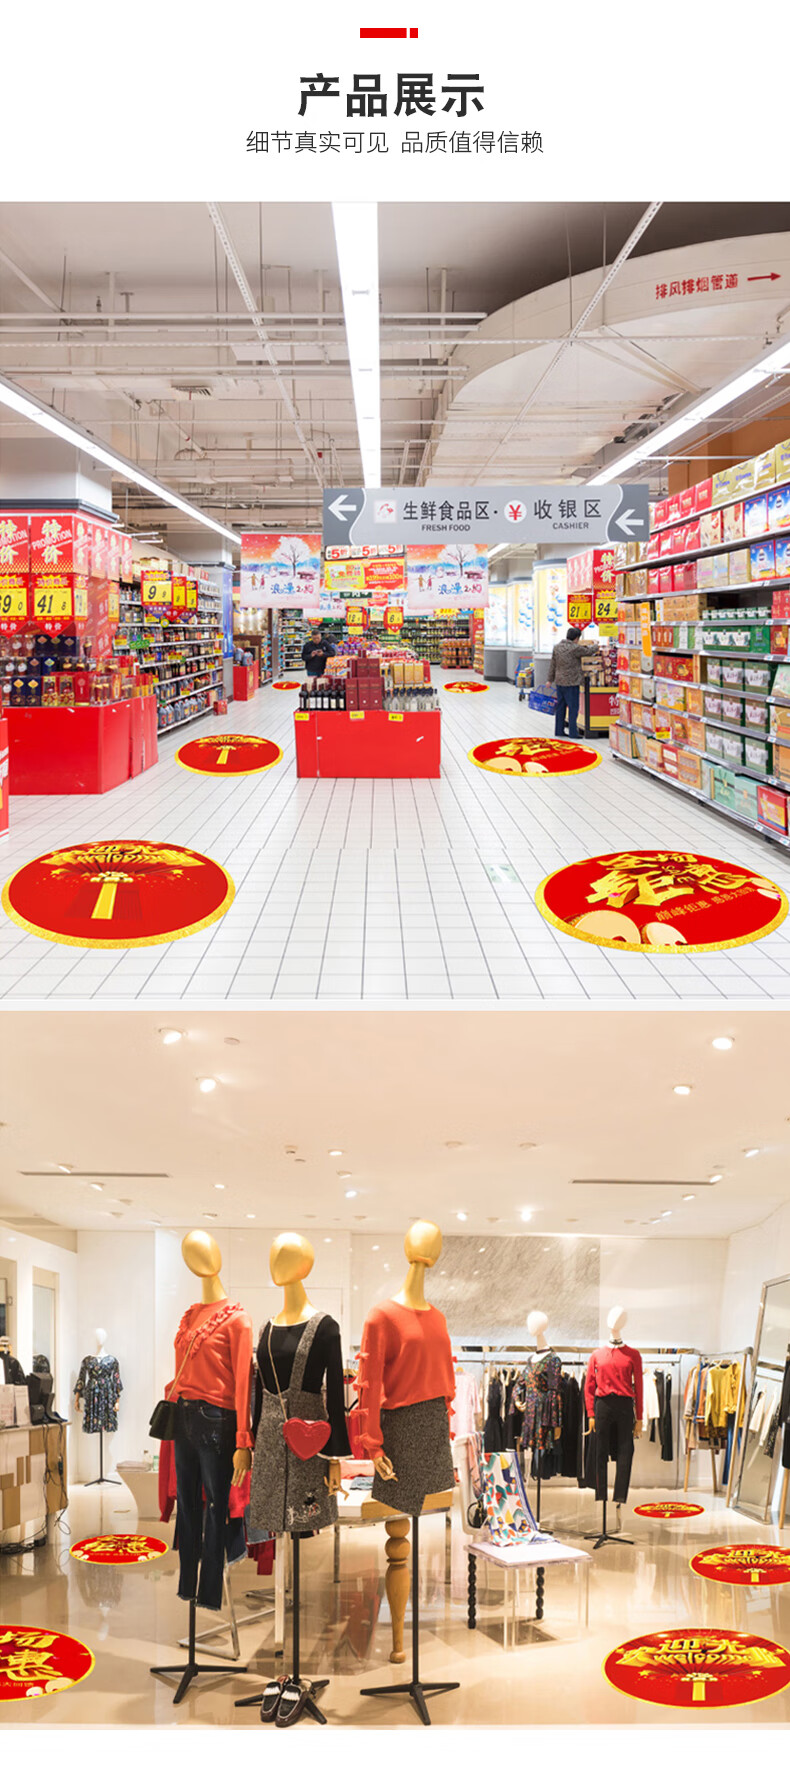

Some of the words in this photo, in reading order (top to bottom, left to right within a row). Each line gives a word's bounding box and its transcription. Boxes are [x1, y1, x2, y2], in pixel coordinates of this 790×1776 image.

[534, 499, 601, 519] 收银区
[553, 522, 589, 530] CASHIER
[148, 585, 157, 600] 9
[37, 594, 54, 613] 41
[597, 603, 611, 616] 24
[569, 606, 580, 617] 21
